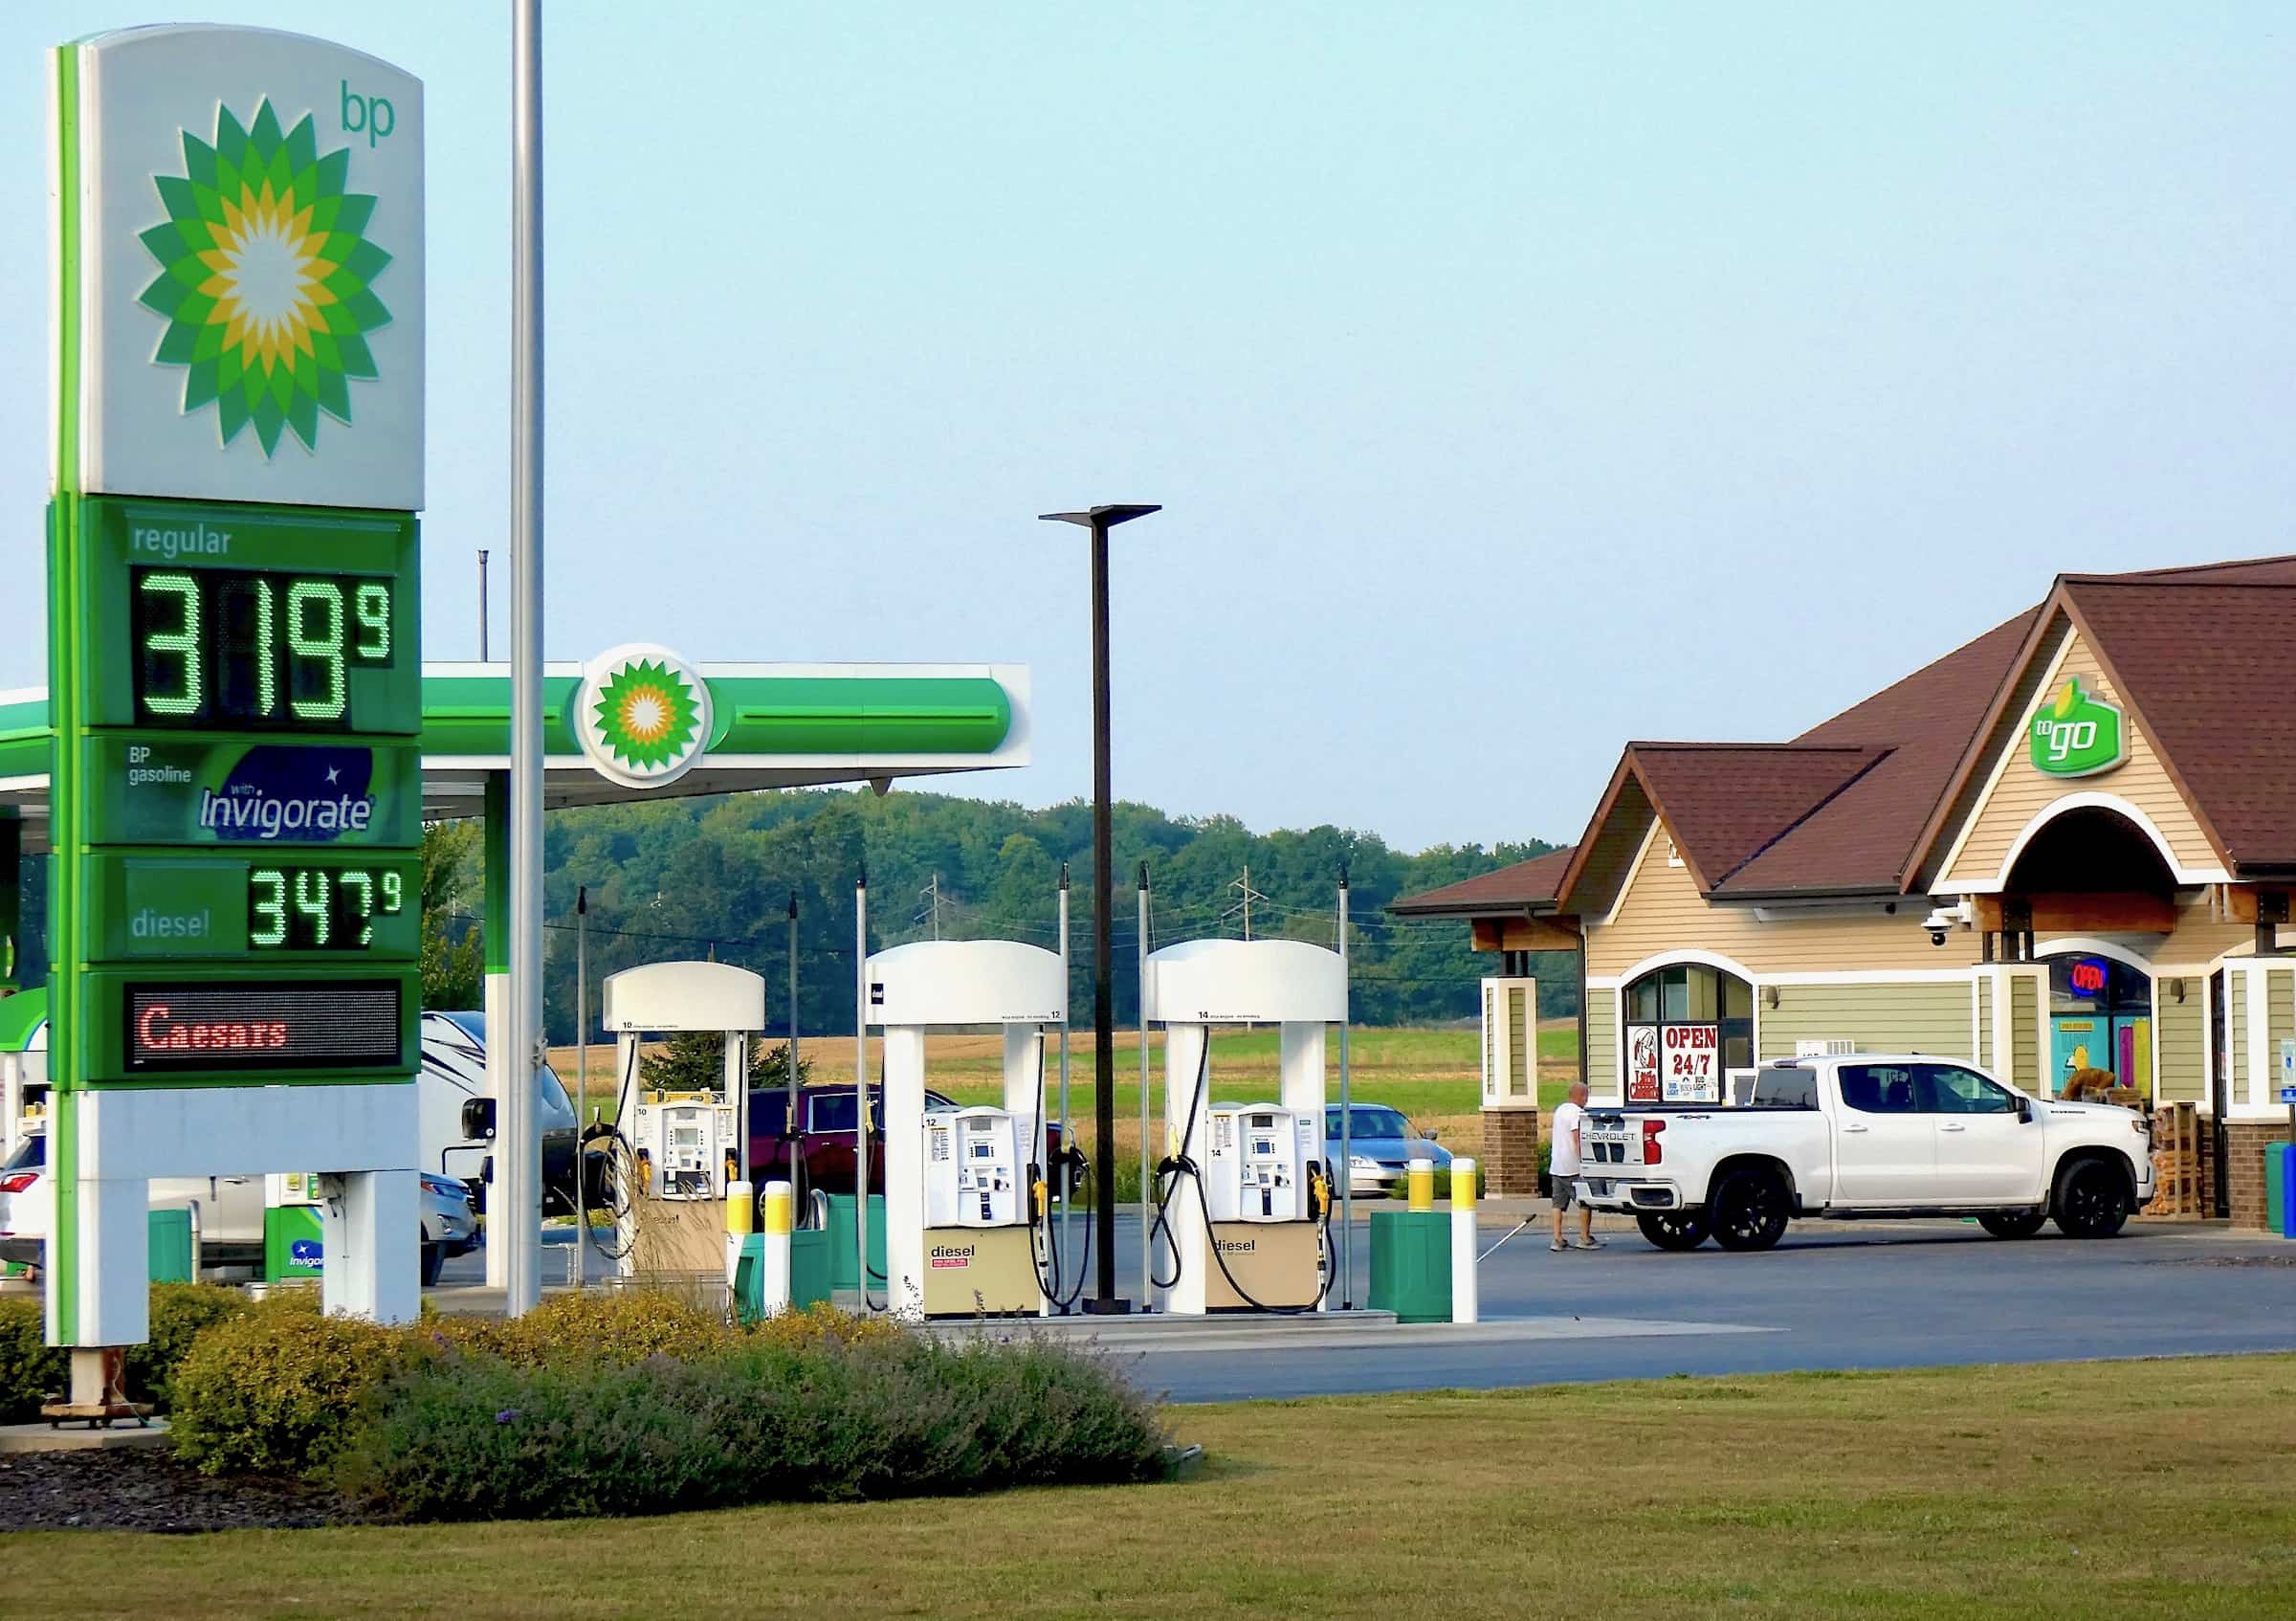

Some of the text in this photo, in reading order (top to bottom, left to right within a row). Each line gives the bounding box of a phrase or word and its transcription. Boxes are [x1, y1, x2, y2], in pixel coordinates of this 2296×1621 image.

[342, 79, 395, 148] bp
[133, 522, 232, 560] regular
[2037, 720, 2098, 762] to go
[129, 746, 151, 764] BP
[129, 766, 192, 786] gasoline
[231, 783, 254, 795] with
[200, 788, 371, 839] Invigorate
[132, 909, 210, 939] diesel
[2073, 964, 2104, 990] OPEN
[1050, 1010, 1061, 1019] 12
[138, 1004, 287, 1050] Caesars
[1666, 1027, 1717, 1049] OPEN
[1673, 1054, 1711, 1076] 24/7
[1581, 1132, 1636, 1141] CHEVROLET
[931, 1244, 976, 1257] diesel
